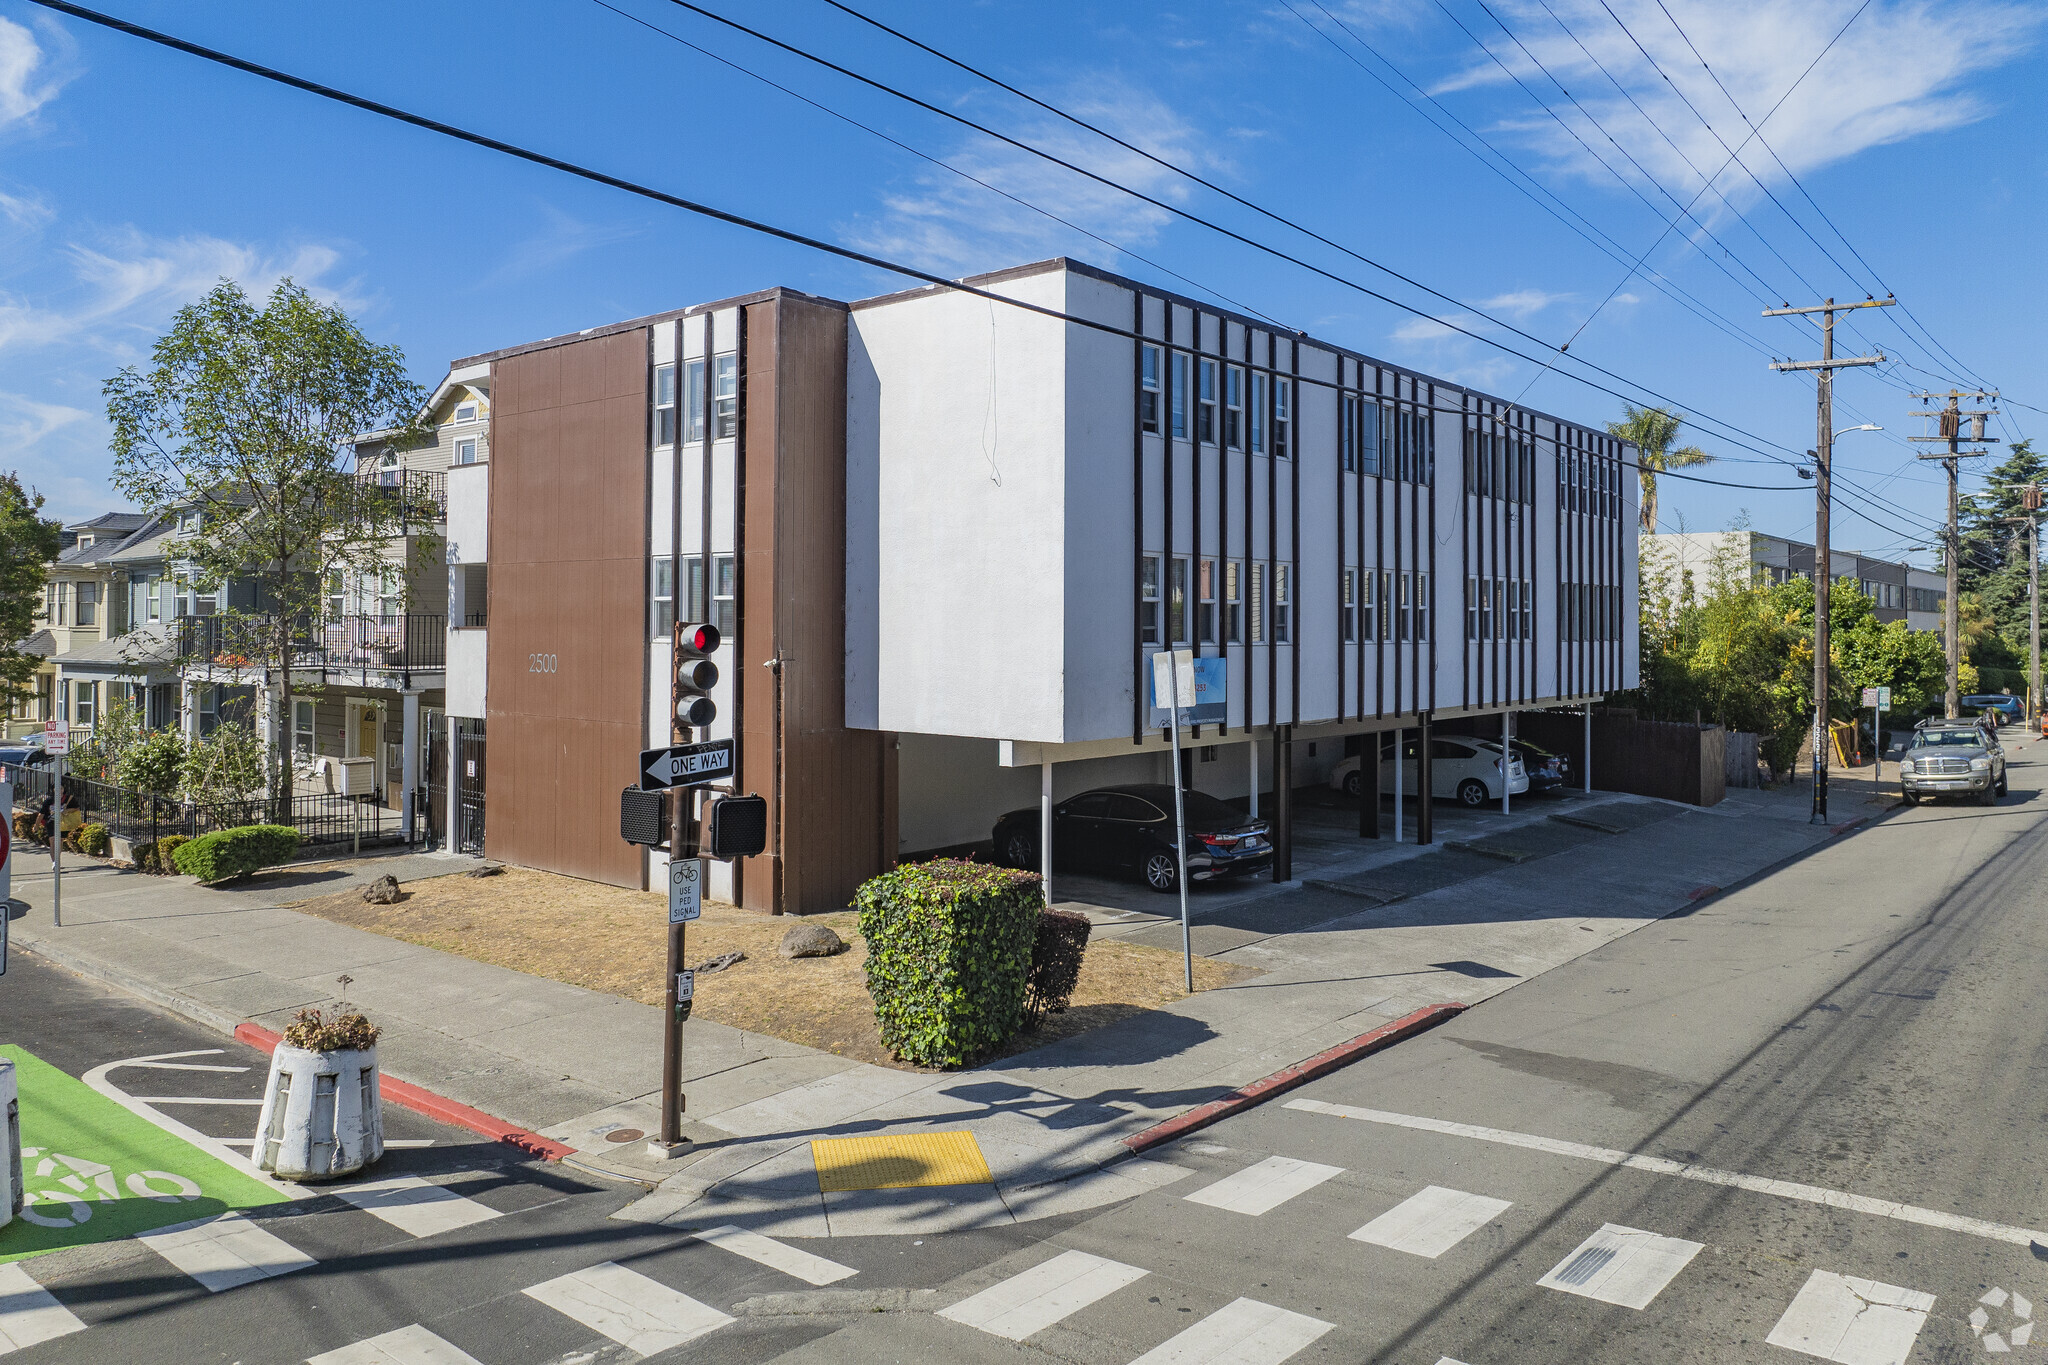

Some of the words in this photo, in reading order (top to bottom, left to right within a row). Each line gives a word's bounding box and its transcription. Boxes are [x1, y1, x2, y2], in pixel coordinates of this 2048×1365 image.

[529, 653, 557, 673] 2500
[48, 722, 55, 730] NO
[671, 756, 697, 775] ONE
[701, 752, 724, 769] WAY
[680, 886, 691, 895] USE
[680, 897, 691, 905] PED
[674, 906, 696, 917] SIGNAL
